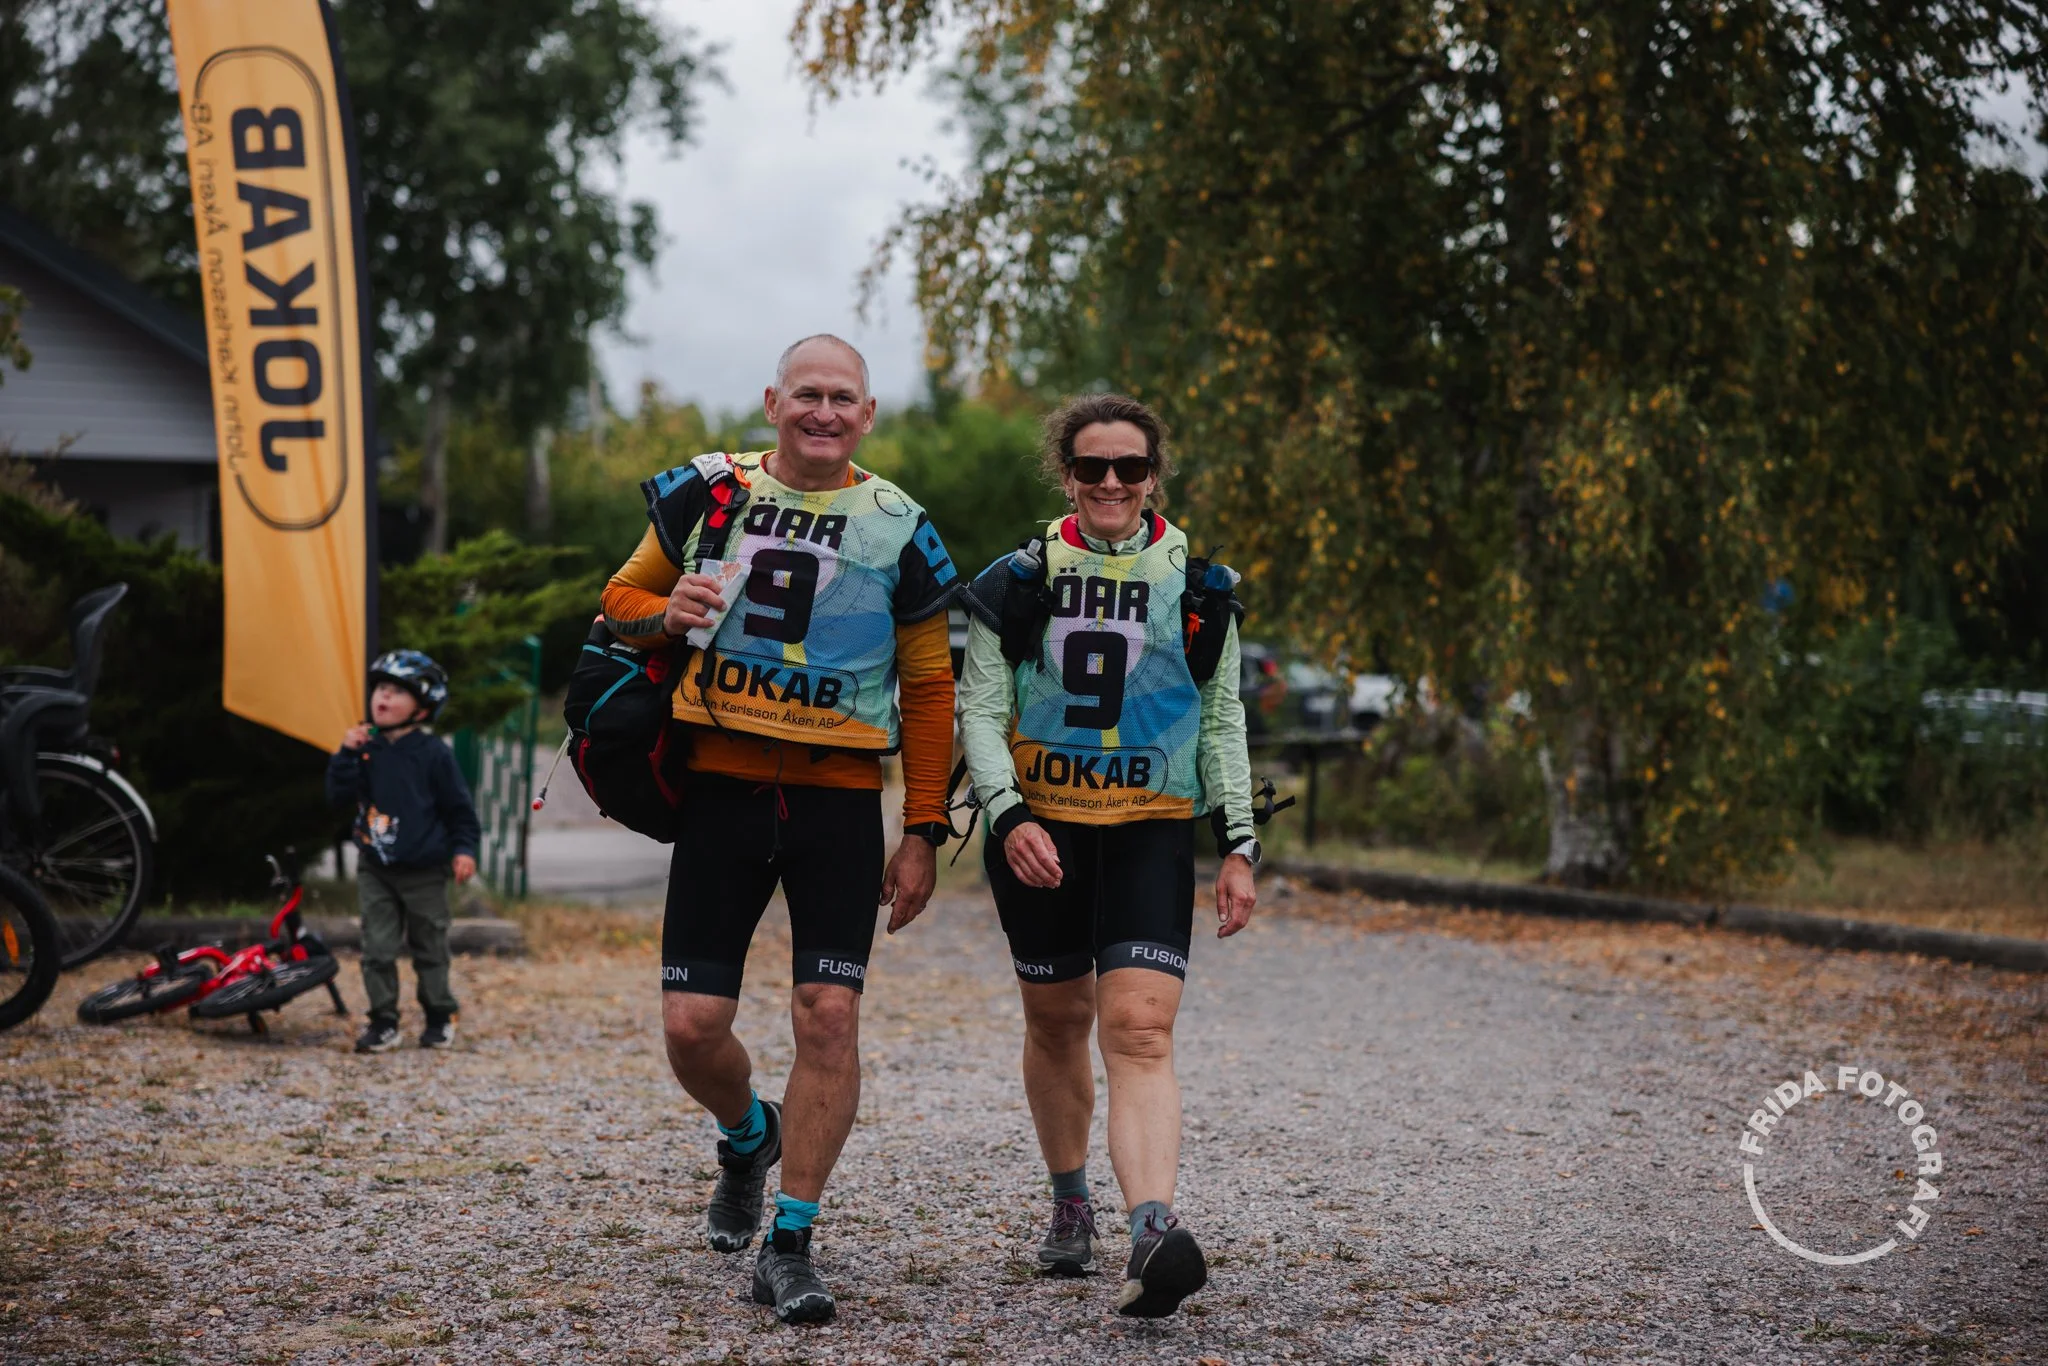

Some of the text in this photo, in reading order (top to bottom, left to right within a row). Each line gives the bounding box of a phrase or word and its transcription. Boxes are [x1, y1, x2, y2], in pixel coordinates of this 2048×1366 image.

[744, 496, 848, 550] ÖAR
[743, 548, 820, 644] 9
[1051, 567, 1150, 623] ÖAR
[694, 654, 843, 709] JOKAB
[1062, 631, 1128, 730] 9
[689, 696, 835, 729] Jon Karlsson Åkeri AB
[1026, 750, 1150, 789] JOKAB
[1025, 790, 1147, 809] John Karlsson Åkeri AB
[1013, 958, 1054, 976] SION
